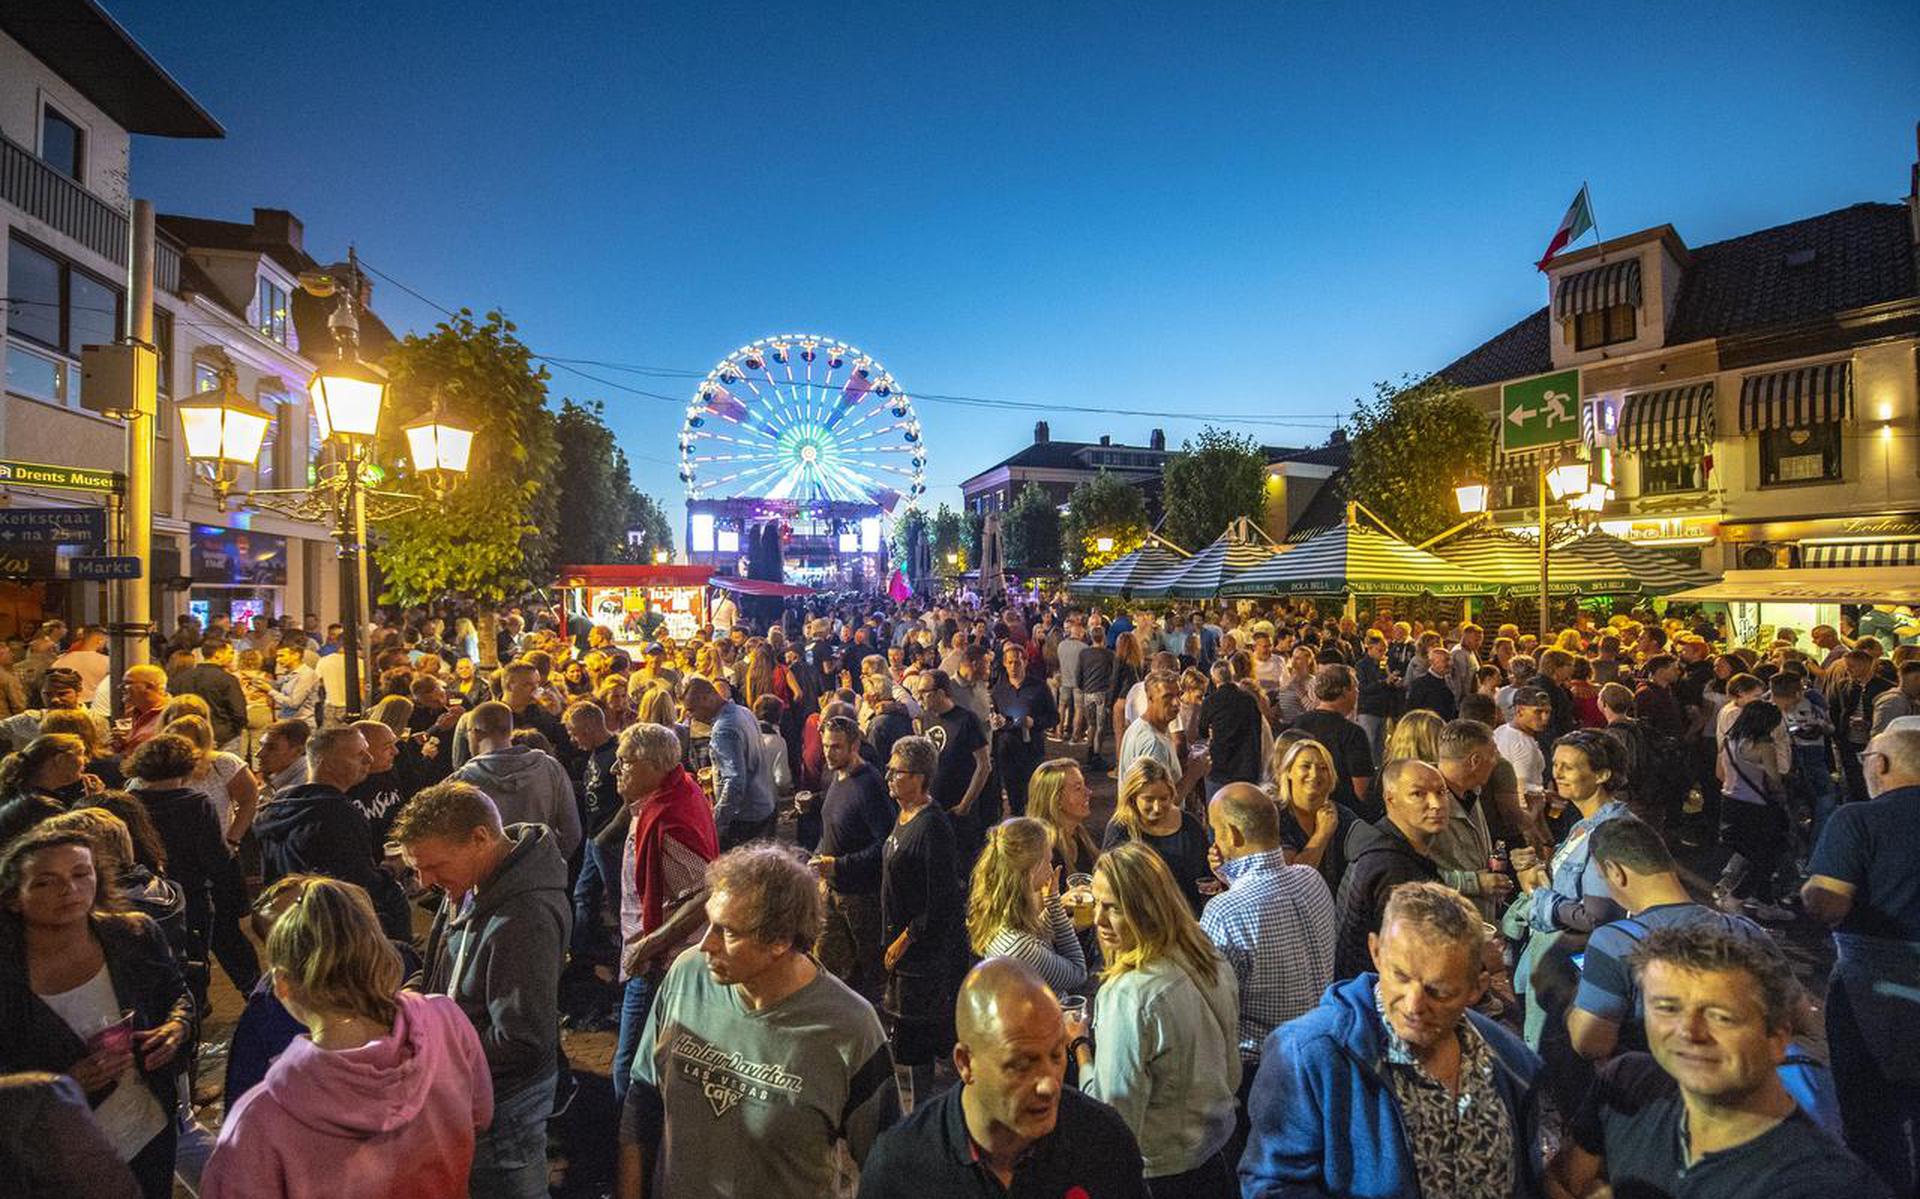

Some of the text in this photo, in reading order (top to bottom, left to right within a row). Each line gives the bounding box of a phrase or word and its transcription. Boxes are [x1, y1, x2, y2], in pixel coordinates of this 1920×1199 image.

[16, 468, 65, 482] Drents
[23, 530, 42, 540] na
[78, 560, 133, 574] Markt
[684, 1063, 711, 1080] LAS
[721, 1075, 768, 1100] VEGAS
